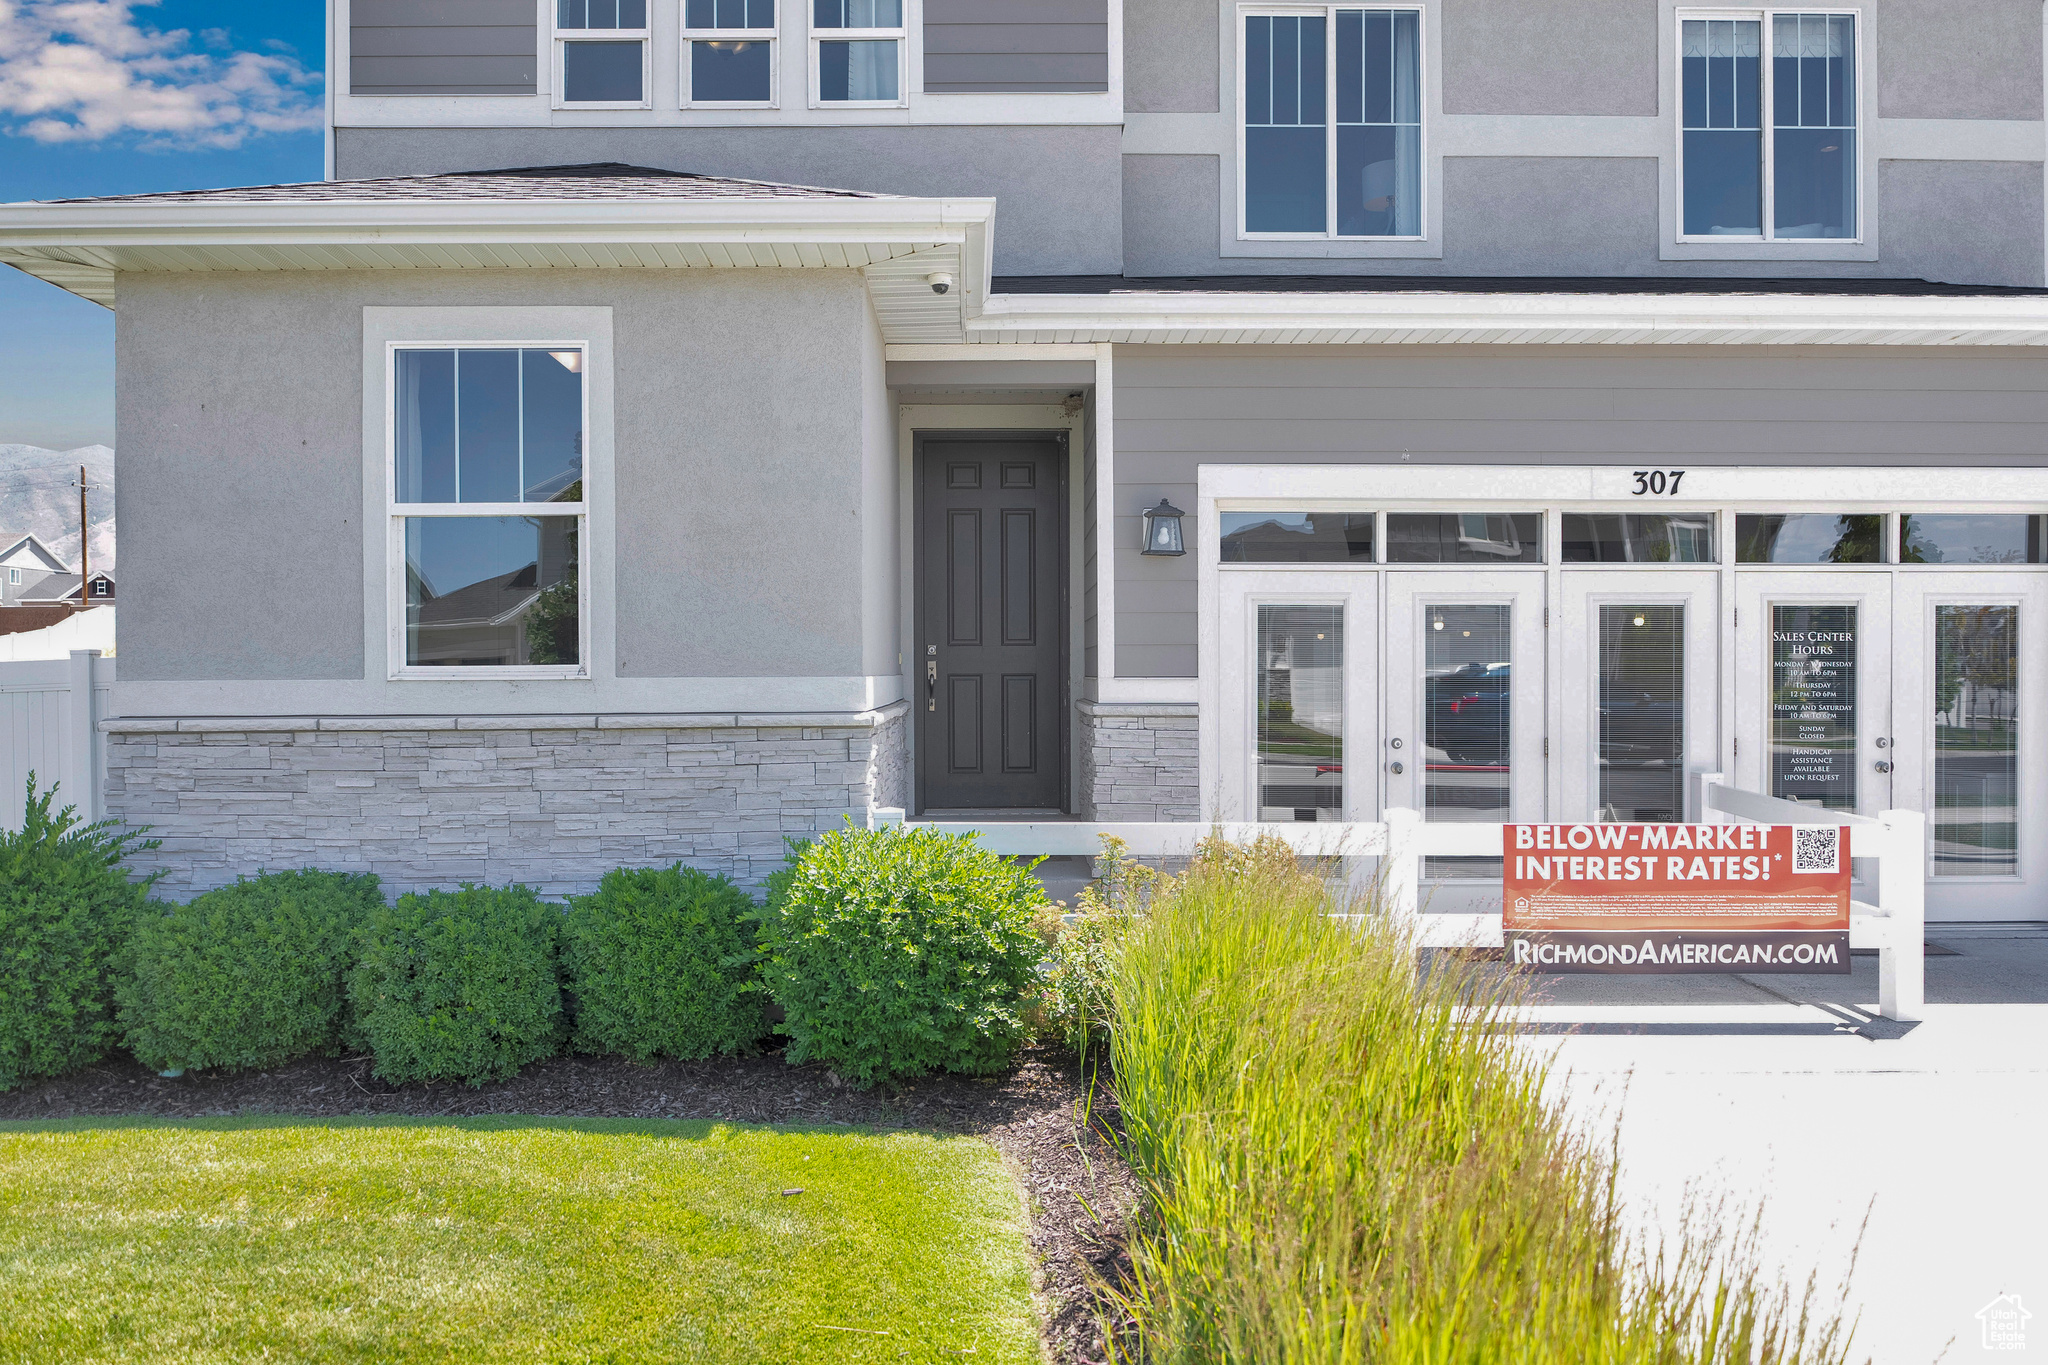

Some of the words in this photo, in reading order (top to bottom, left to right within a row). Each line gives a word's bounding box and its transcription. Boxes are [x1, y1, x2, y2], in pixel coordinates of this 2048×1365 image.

[1631, 469, 1686, 496] 307
[1773, 631, 1805, 642] SALES
[1807, 631, 1853, 642] CENTER
[1792, 644, 1833, 655] HOURS
[1807, 774, 1840, 782] REQUEST
[1515, 825, 1772, 850] BELOW-MARKET
[1515, 855, 1662, 881] INTEREST
